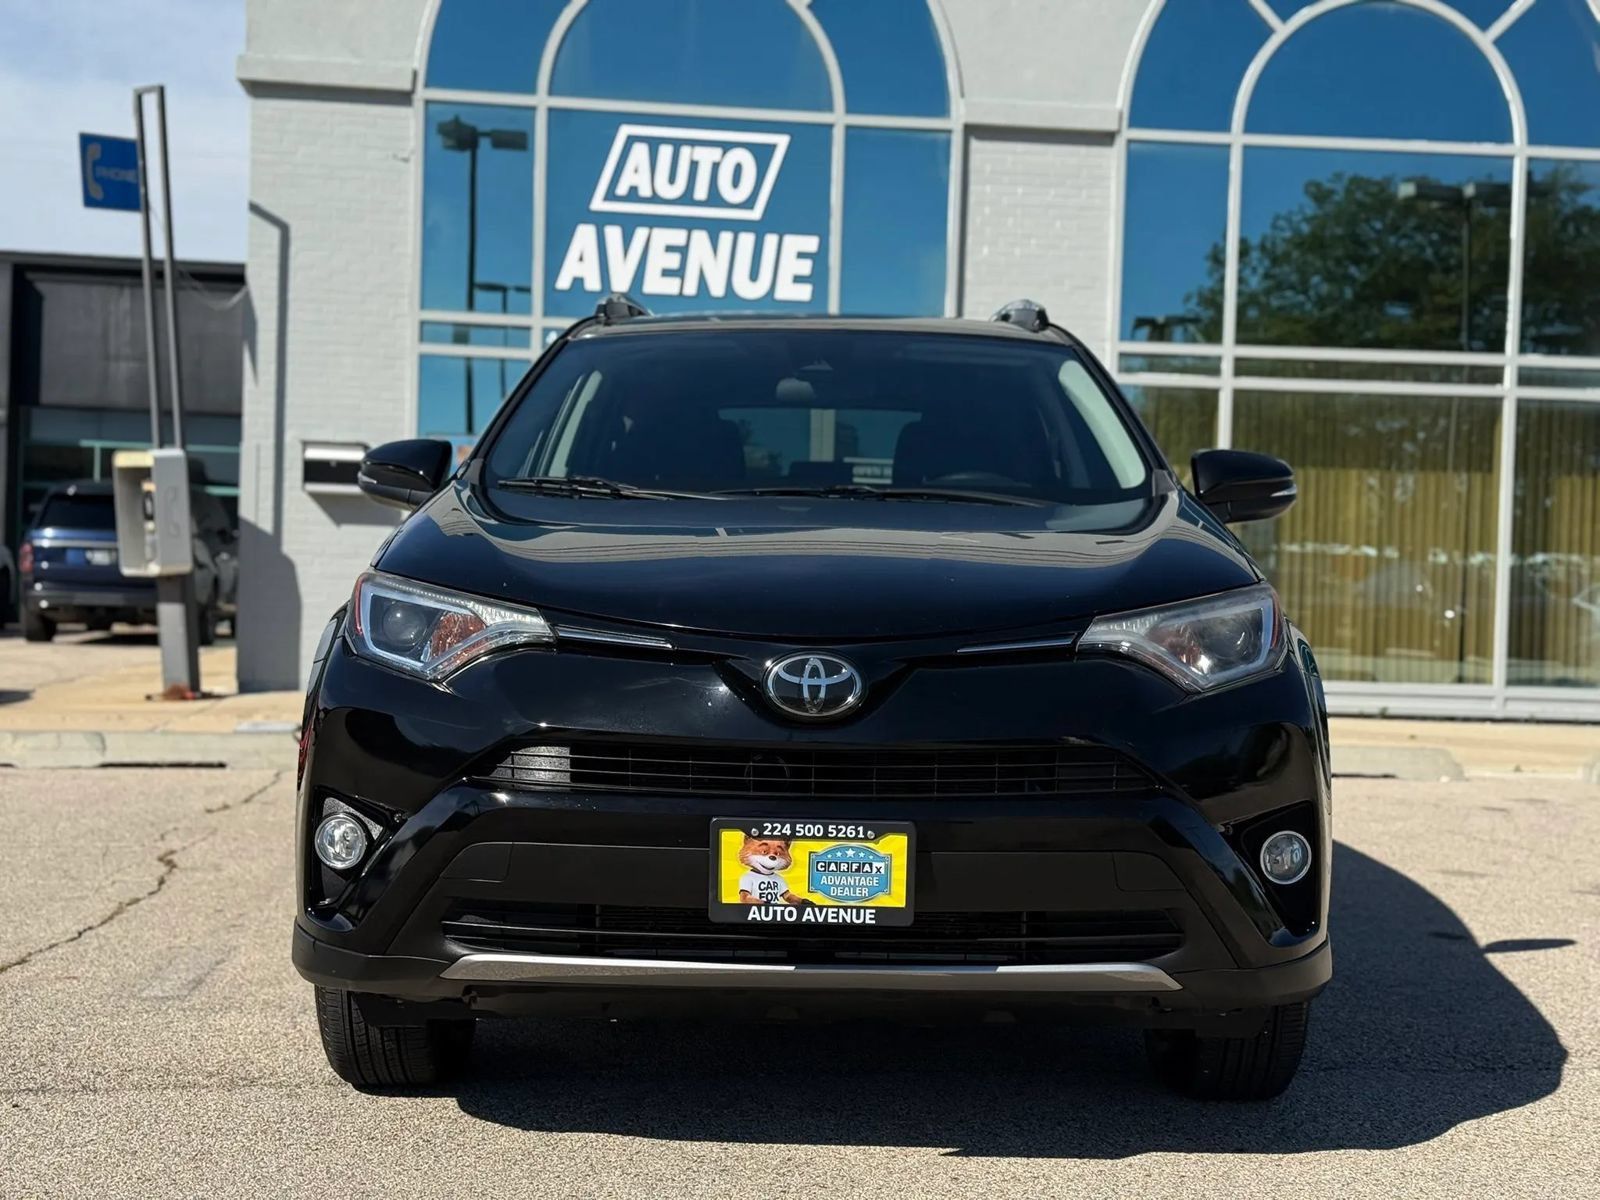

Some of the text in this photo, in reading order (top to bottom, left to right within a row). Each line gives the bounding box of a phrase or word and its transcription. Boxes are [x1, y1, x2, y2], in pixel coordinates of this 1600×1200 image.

[614, 141, 758, 205] AUTO
[554, 223, 820, 302] AVENUE
[763, 822, 865, 838] 224 500 5261
[816, 861, 884, 874] CARFAX
[758, 881, 779, 892] CAR
[820, 875, 879, 887] ADVANTAGE
[758, 891, 779, 902] FOX
[830, 887, 869, 897] DEALER
[747, 906, 876, 924] AUTO AVENUE
